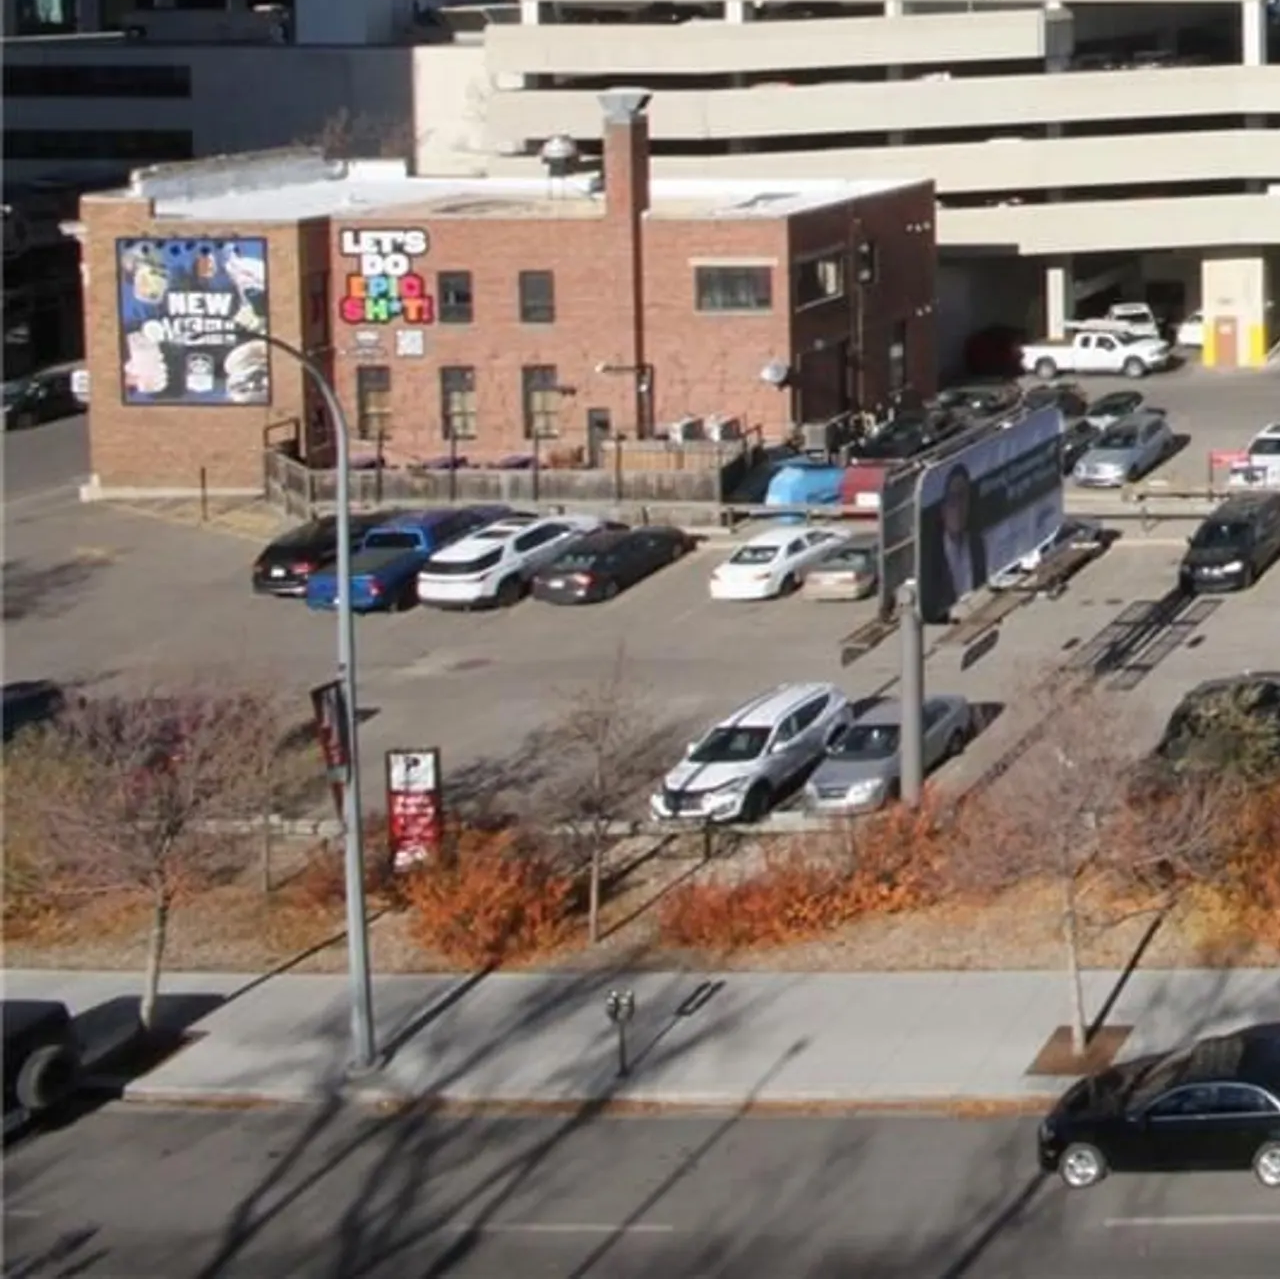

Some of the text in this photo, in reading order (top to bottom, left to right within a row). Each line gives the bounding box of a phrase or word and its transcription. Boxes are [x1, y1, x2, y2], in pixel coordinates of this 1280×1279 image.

[342, 230, 427, 254] LET'S
[362, 254, 410, 276] DO
[349, 274, 422, 298] EPIC
[167, 292, 232, 316] NEW
